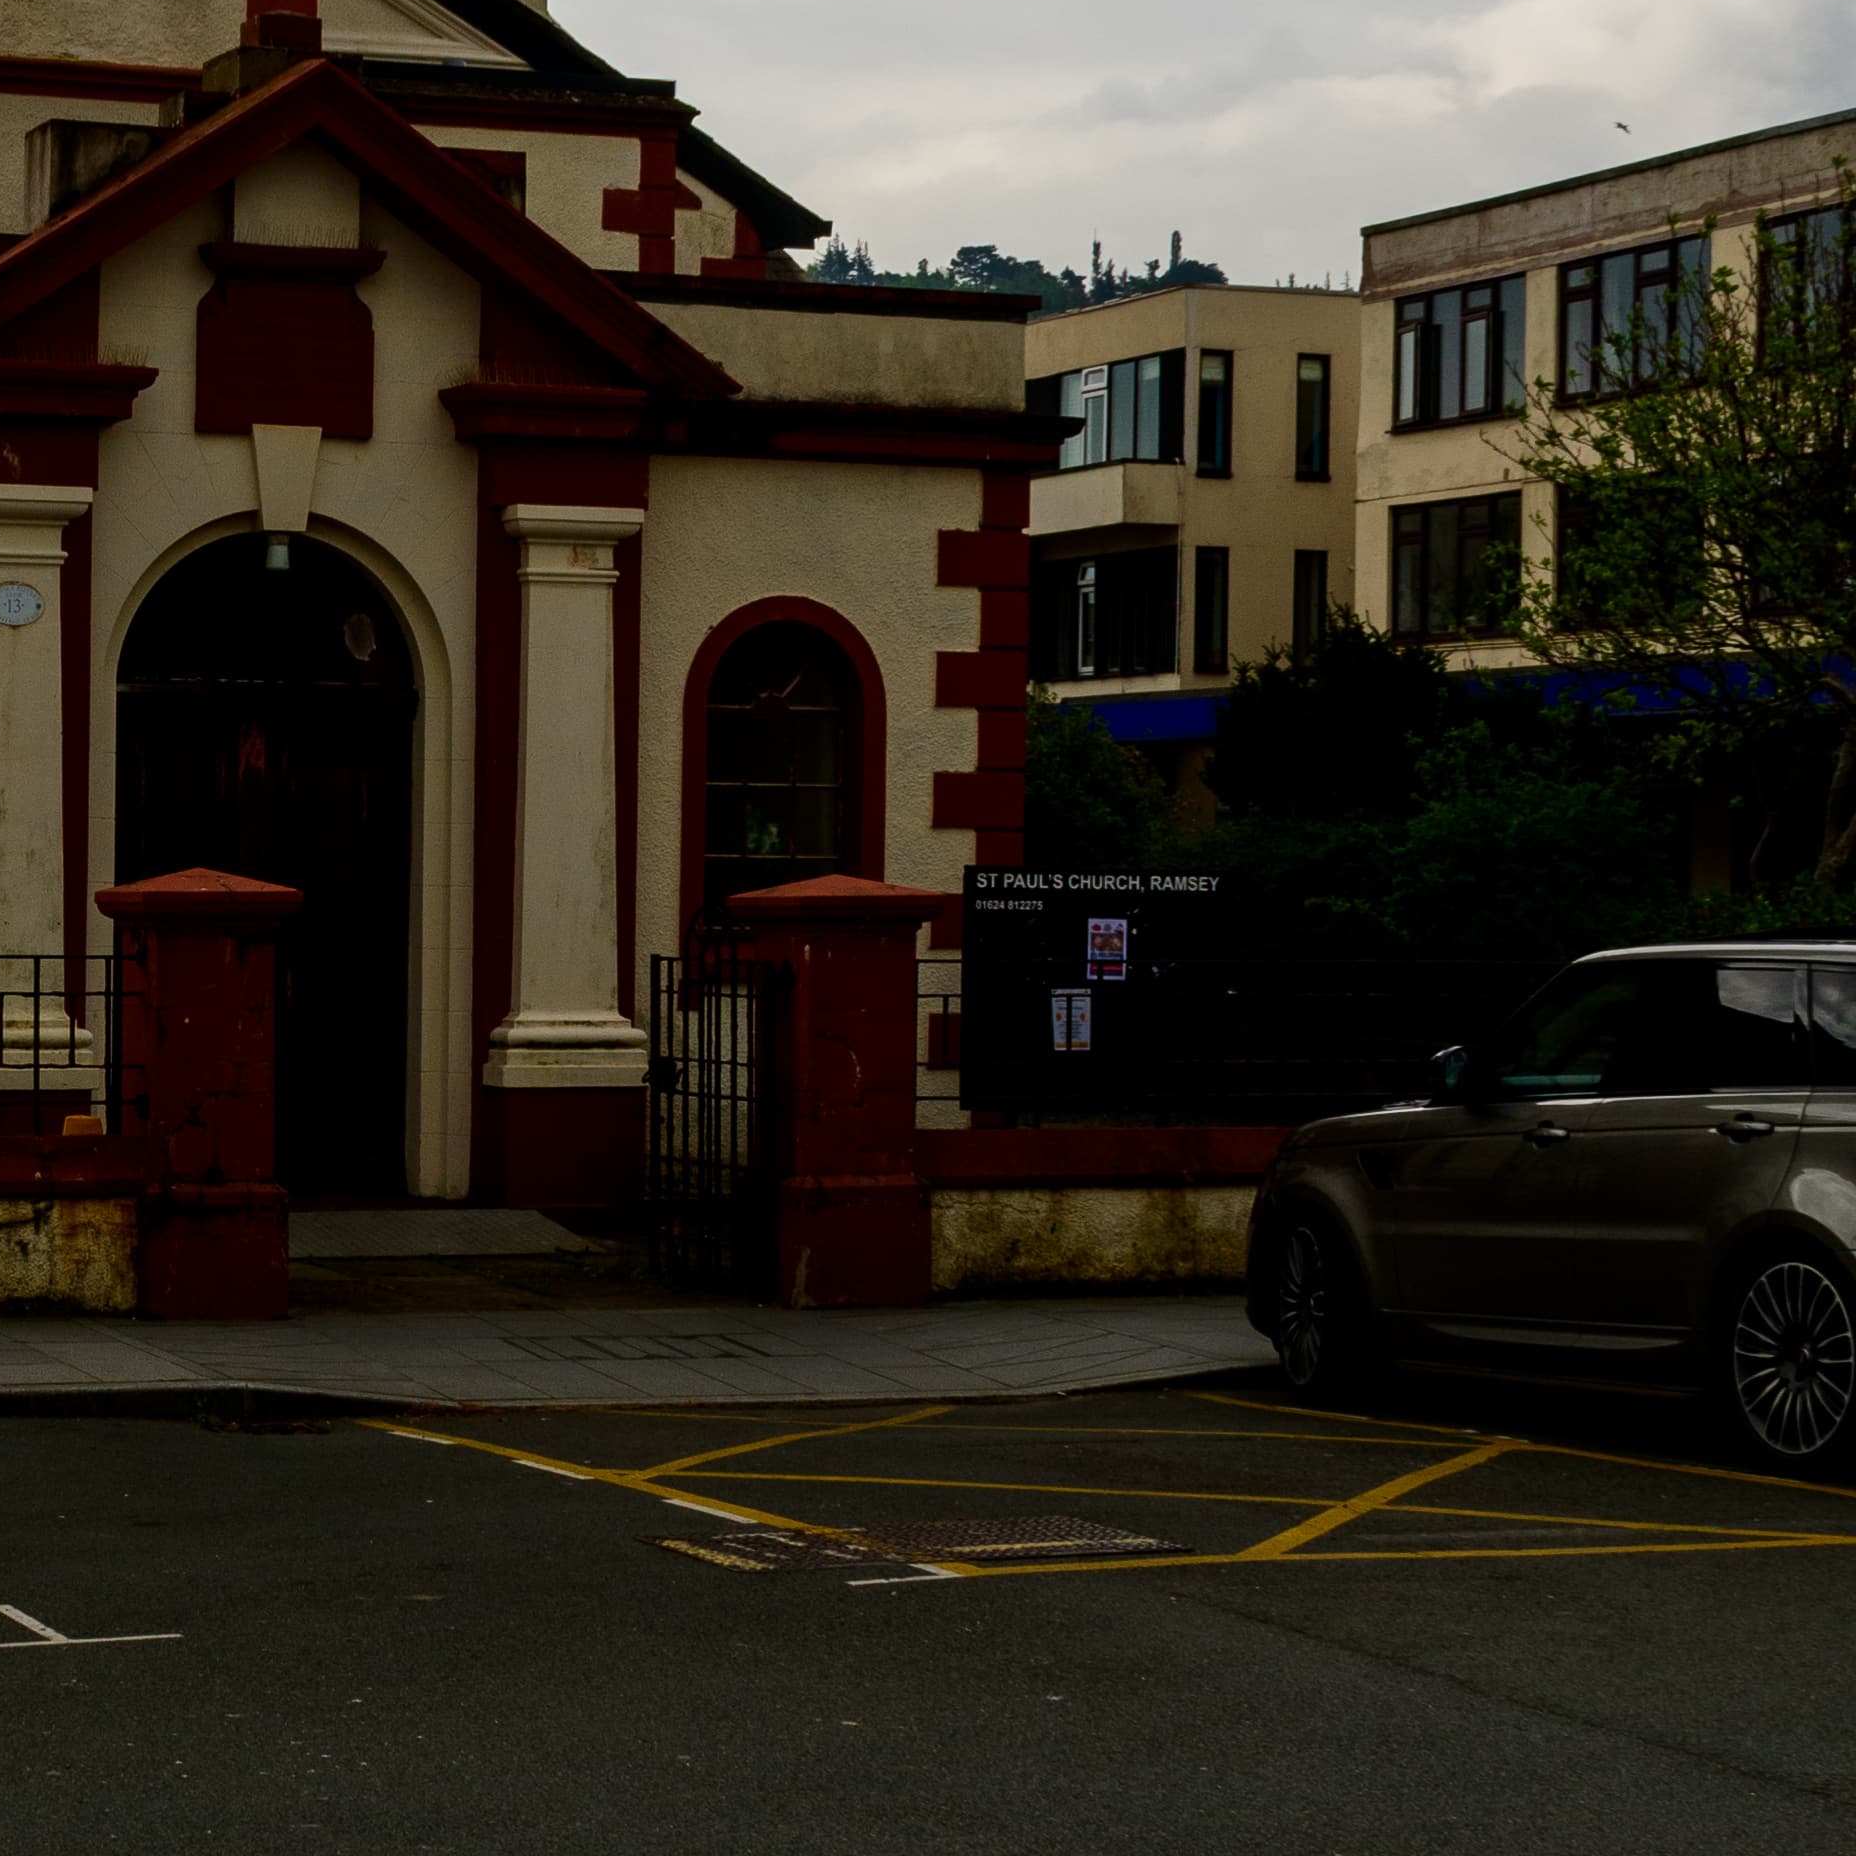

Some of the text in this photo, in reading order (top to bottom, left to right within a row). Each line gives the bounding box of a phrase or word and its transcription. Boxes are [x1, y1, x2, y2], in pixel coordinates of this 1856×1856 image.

[976, 872, 1220, 893] ST PAUL'S CHURCH, RAMSEY
[975, 899, 1044, 911] 01624 812275
